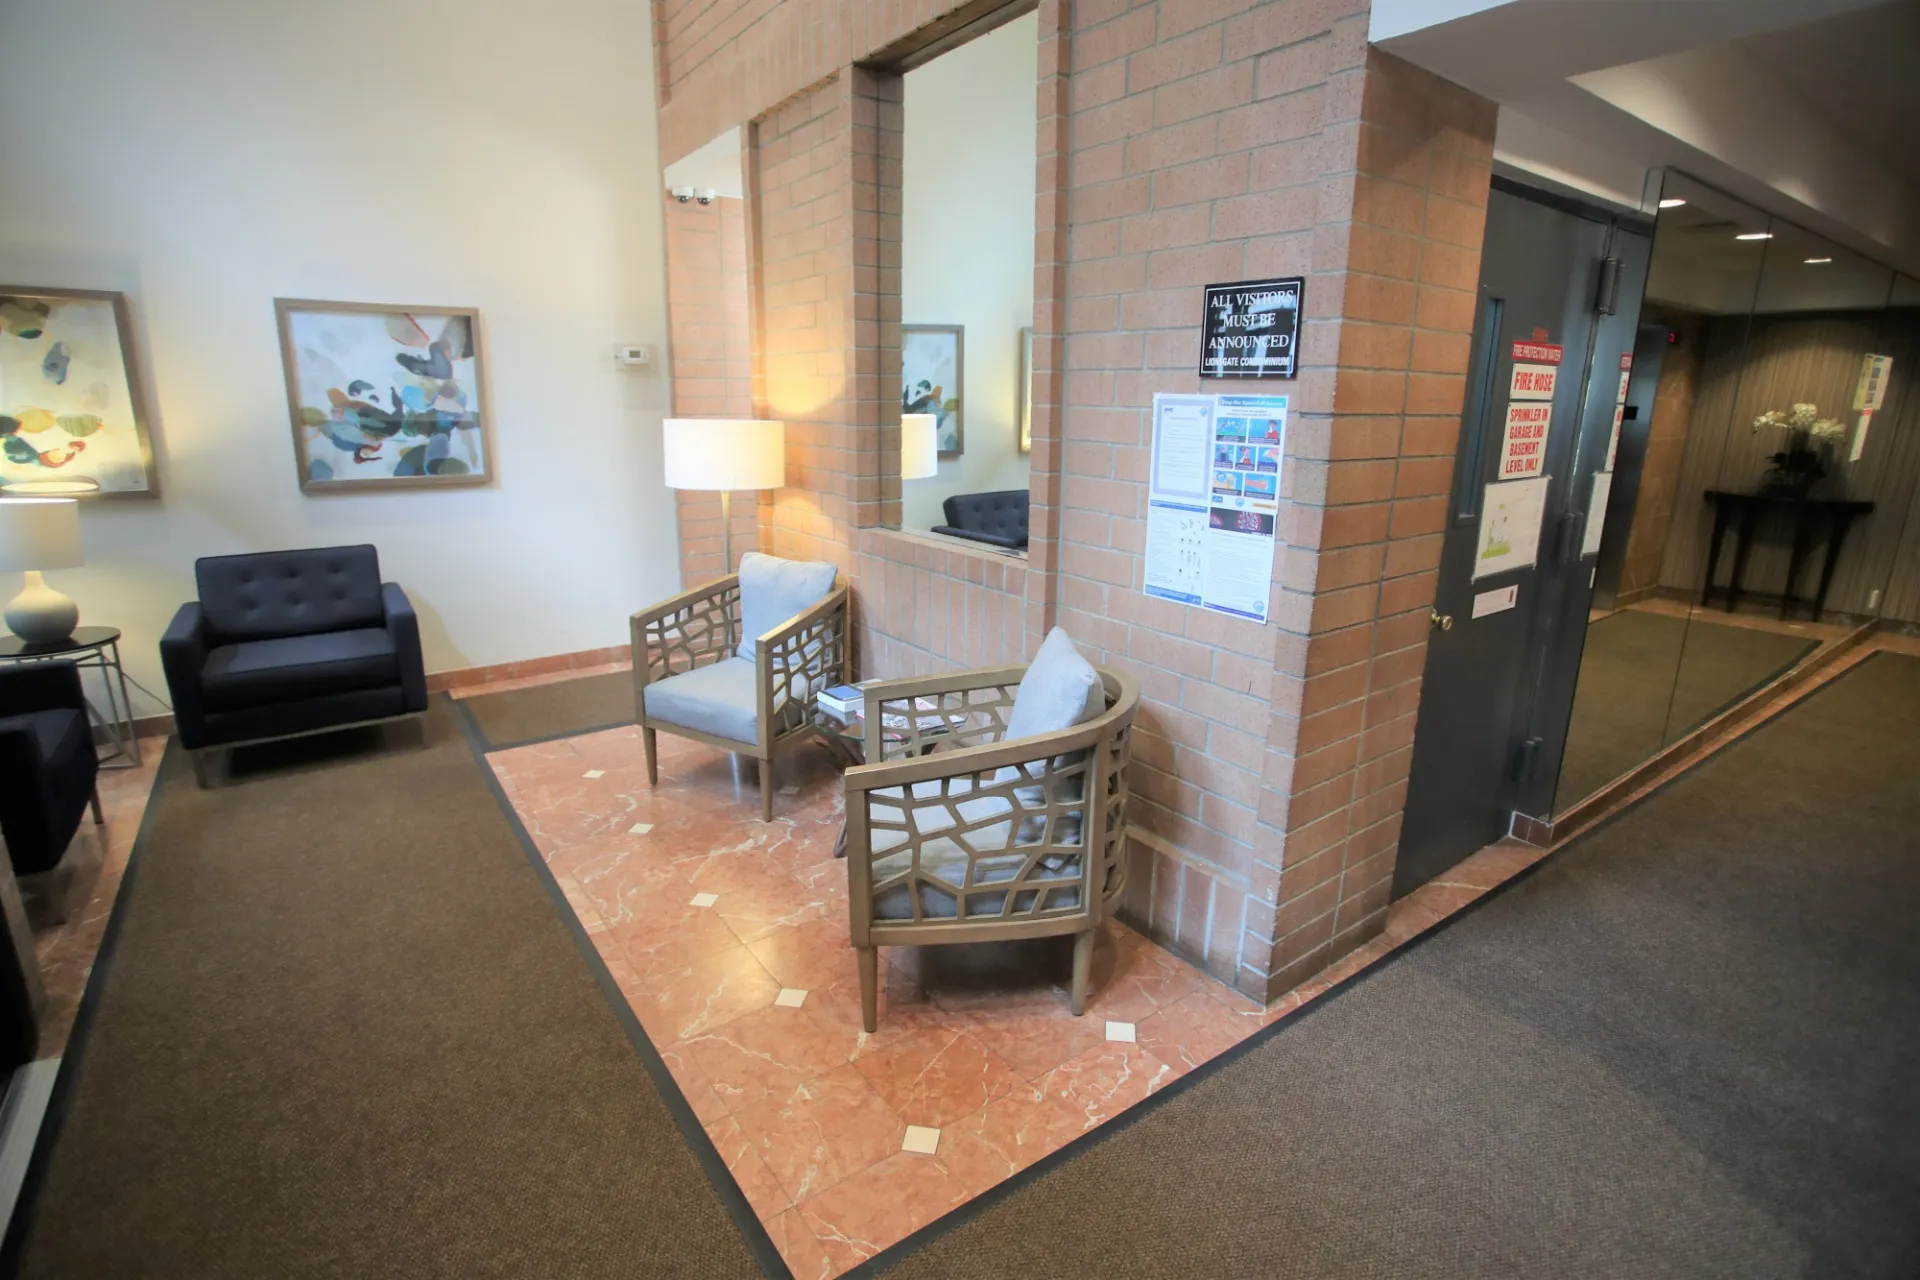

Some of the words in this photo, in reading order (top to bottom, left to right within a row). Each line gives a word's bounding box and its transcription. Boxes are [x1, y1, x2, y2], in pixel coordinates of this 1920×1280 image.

[1210, 295, 1233, 308] ALL
[1236, 290, 1294, 306] VISITORS
[1223, 314, 1258, 328] MUST
[1259, 313, 1276, 326] BE
[1209, 335, 1289, 349] ANNOUNCED
[1514, 371, 1533, 391] FIRE
[1533, 372, 1553, 392] HOSE
[1510, 408, 1541, 422] SPRINKLER
[1541, 408, 1549, 421] IN
[1509, 425, 1532, 439] GARAGE
[1532, 424, 1544, 438] AND
[1509, 441, 1539, 456] BASEMENT
[1505, 459, 1523, 473] LEVEL
[1525, 458, 1539, 471] ONLY
